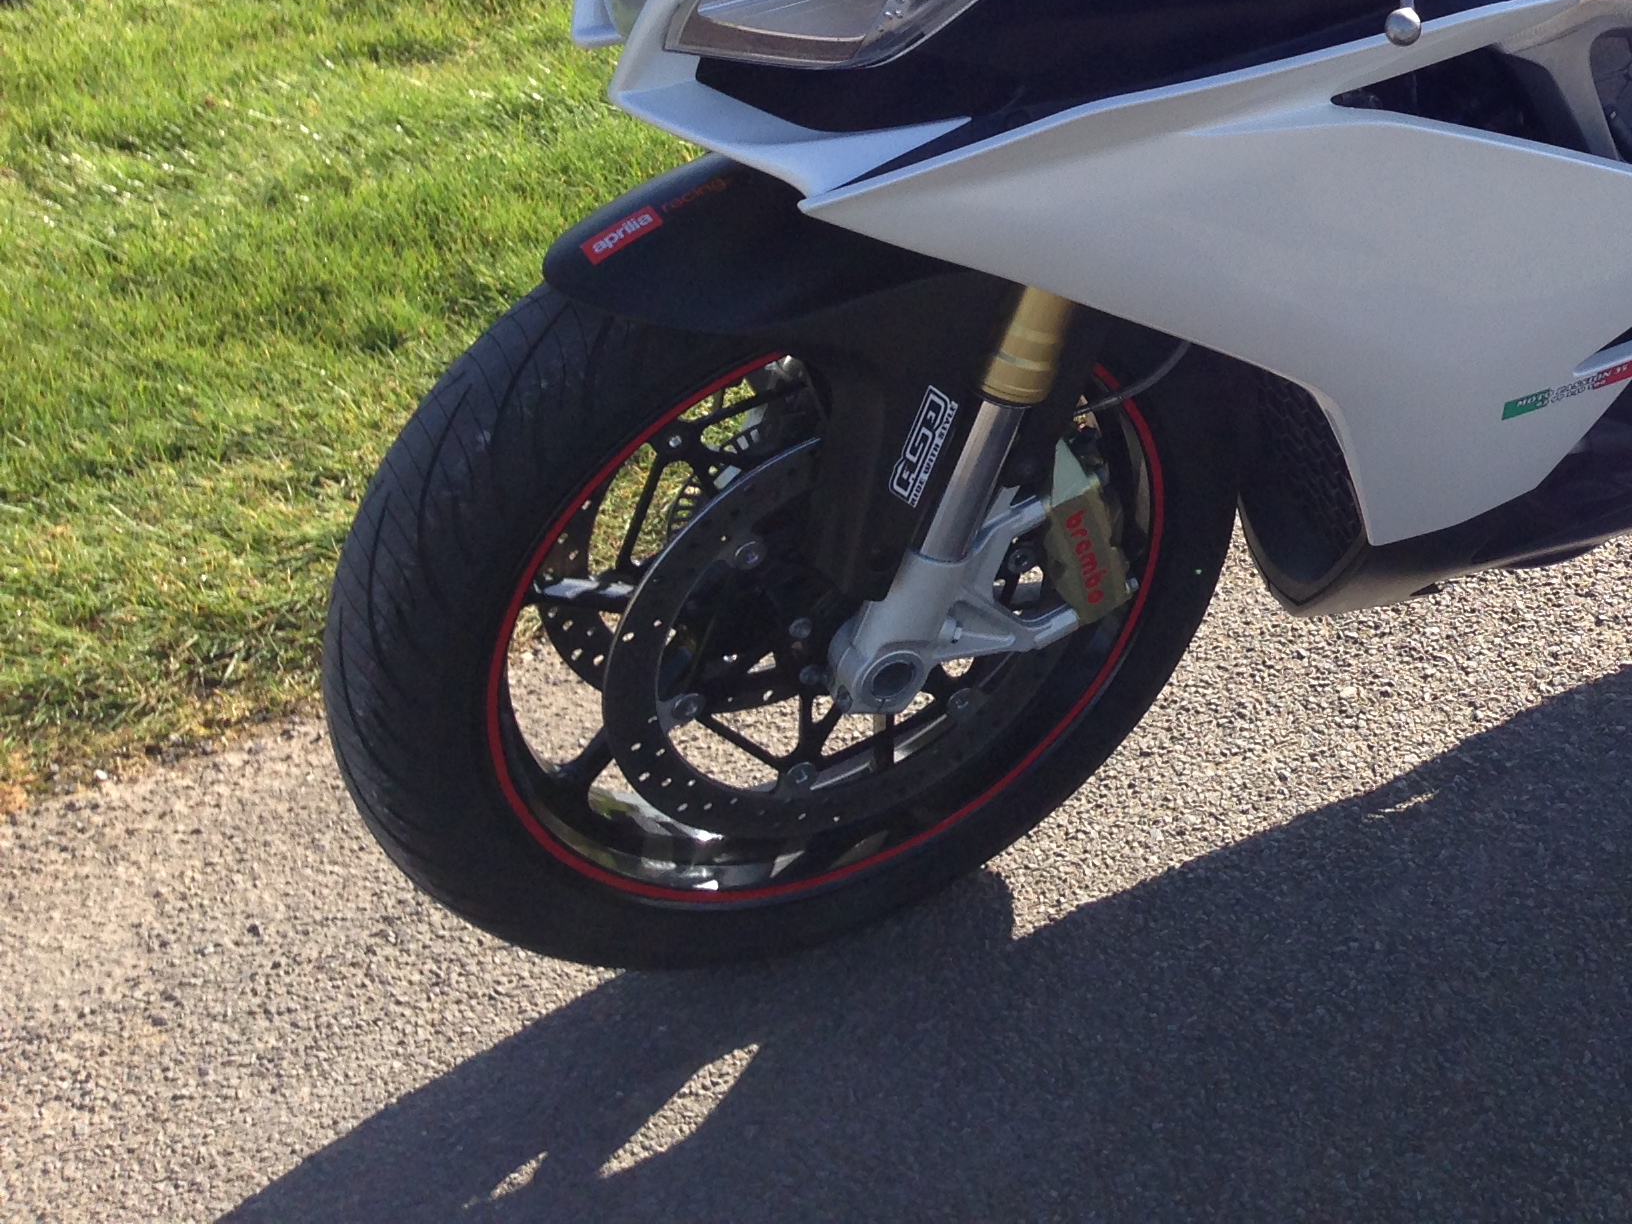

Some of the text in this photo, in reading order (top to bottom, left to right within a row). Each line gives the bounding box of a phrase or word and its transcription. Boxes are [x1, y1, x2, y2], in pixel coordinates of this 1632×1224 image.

[592, 177, 728, 254] aprilia racing
[910, 403, 958, 506] RIDE WITH STYLE
[1066, 509, 1107, 605] brembo
